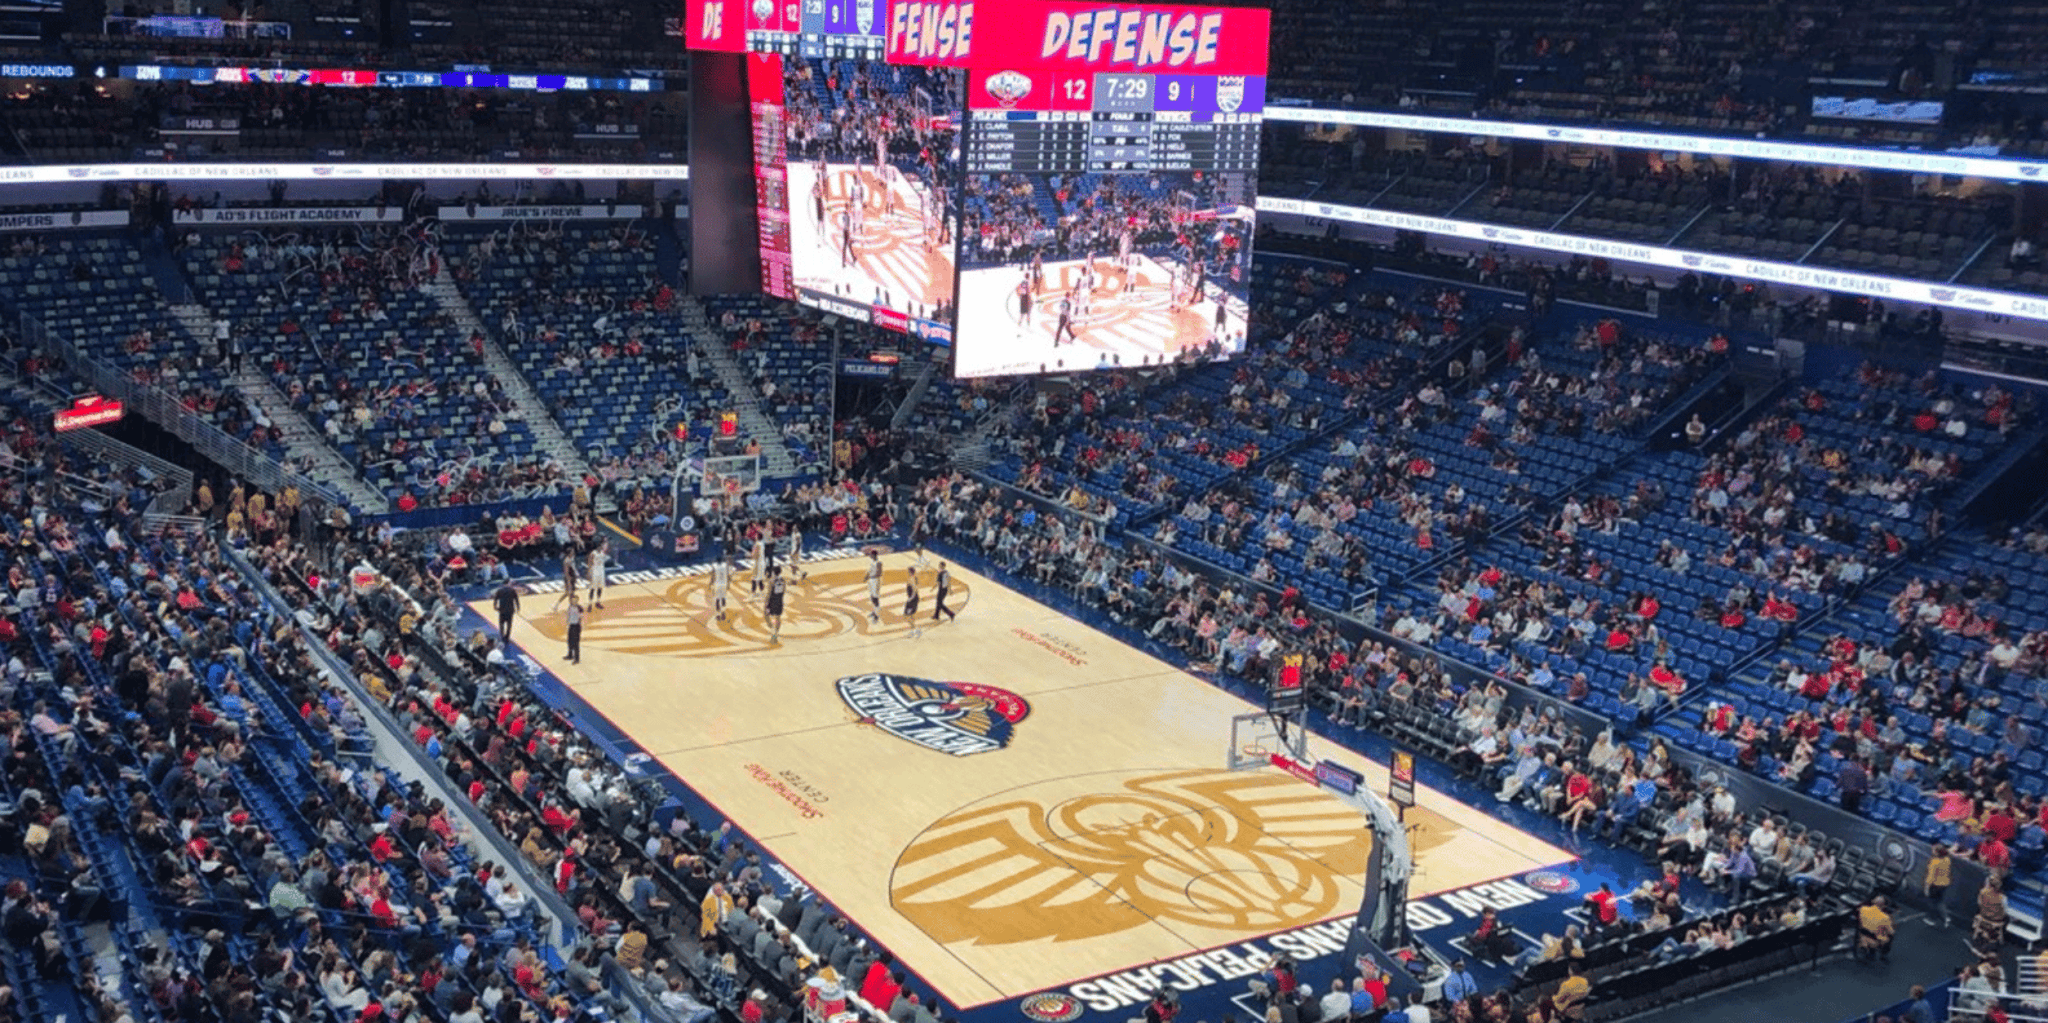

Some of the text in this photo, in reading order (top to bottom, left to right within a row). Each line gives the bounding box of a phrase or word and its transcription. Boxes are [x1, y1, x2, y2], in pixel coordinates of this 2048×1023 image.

[702, 2, 722, 40] DE
[891, 2, 974, 59] FENSE
[1041, 9, 1222, 67] DEFENSE
[1, 65, 74, 77] REBOUNDS
[1063, 79, 1087, 100] 12
[1106, 79, 1148, 99] 7:29
[1168, 81, 1180, 101] 9
[185, 119, 214, 129] HUB
[215, 208, 362, 221] AD'S FLIGHT ACADEMY
[1746, 263, 1796, 281] CADILLAC
[1813, 273, 1838, 287] NEW
[1840, 277, 1891, 294] ORLEANS
[840, 674, 925, 728] ORLEANS
[902, 727, 992, 755] NEW
[1069, 878, 1548, 1011] NEW ORANS PELICANS
